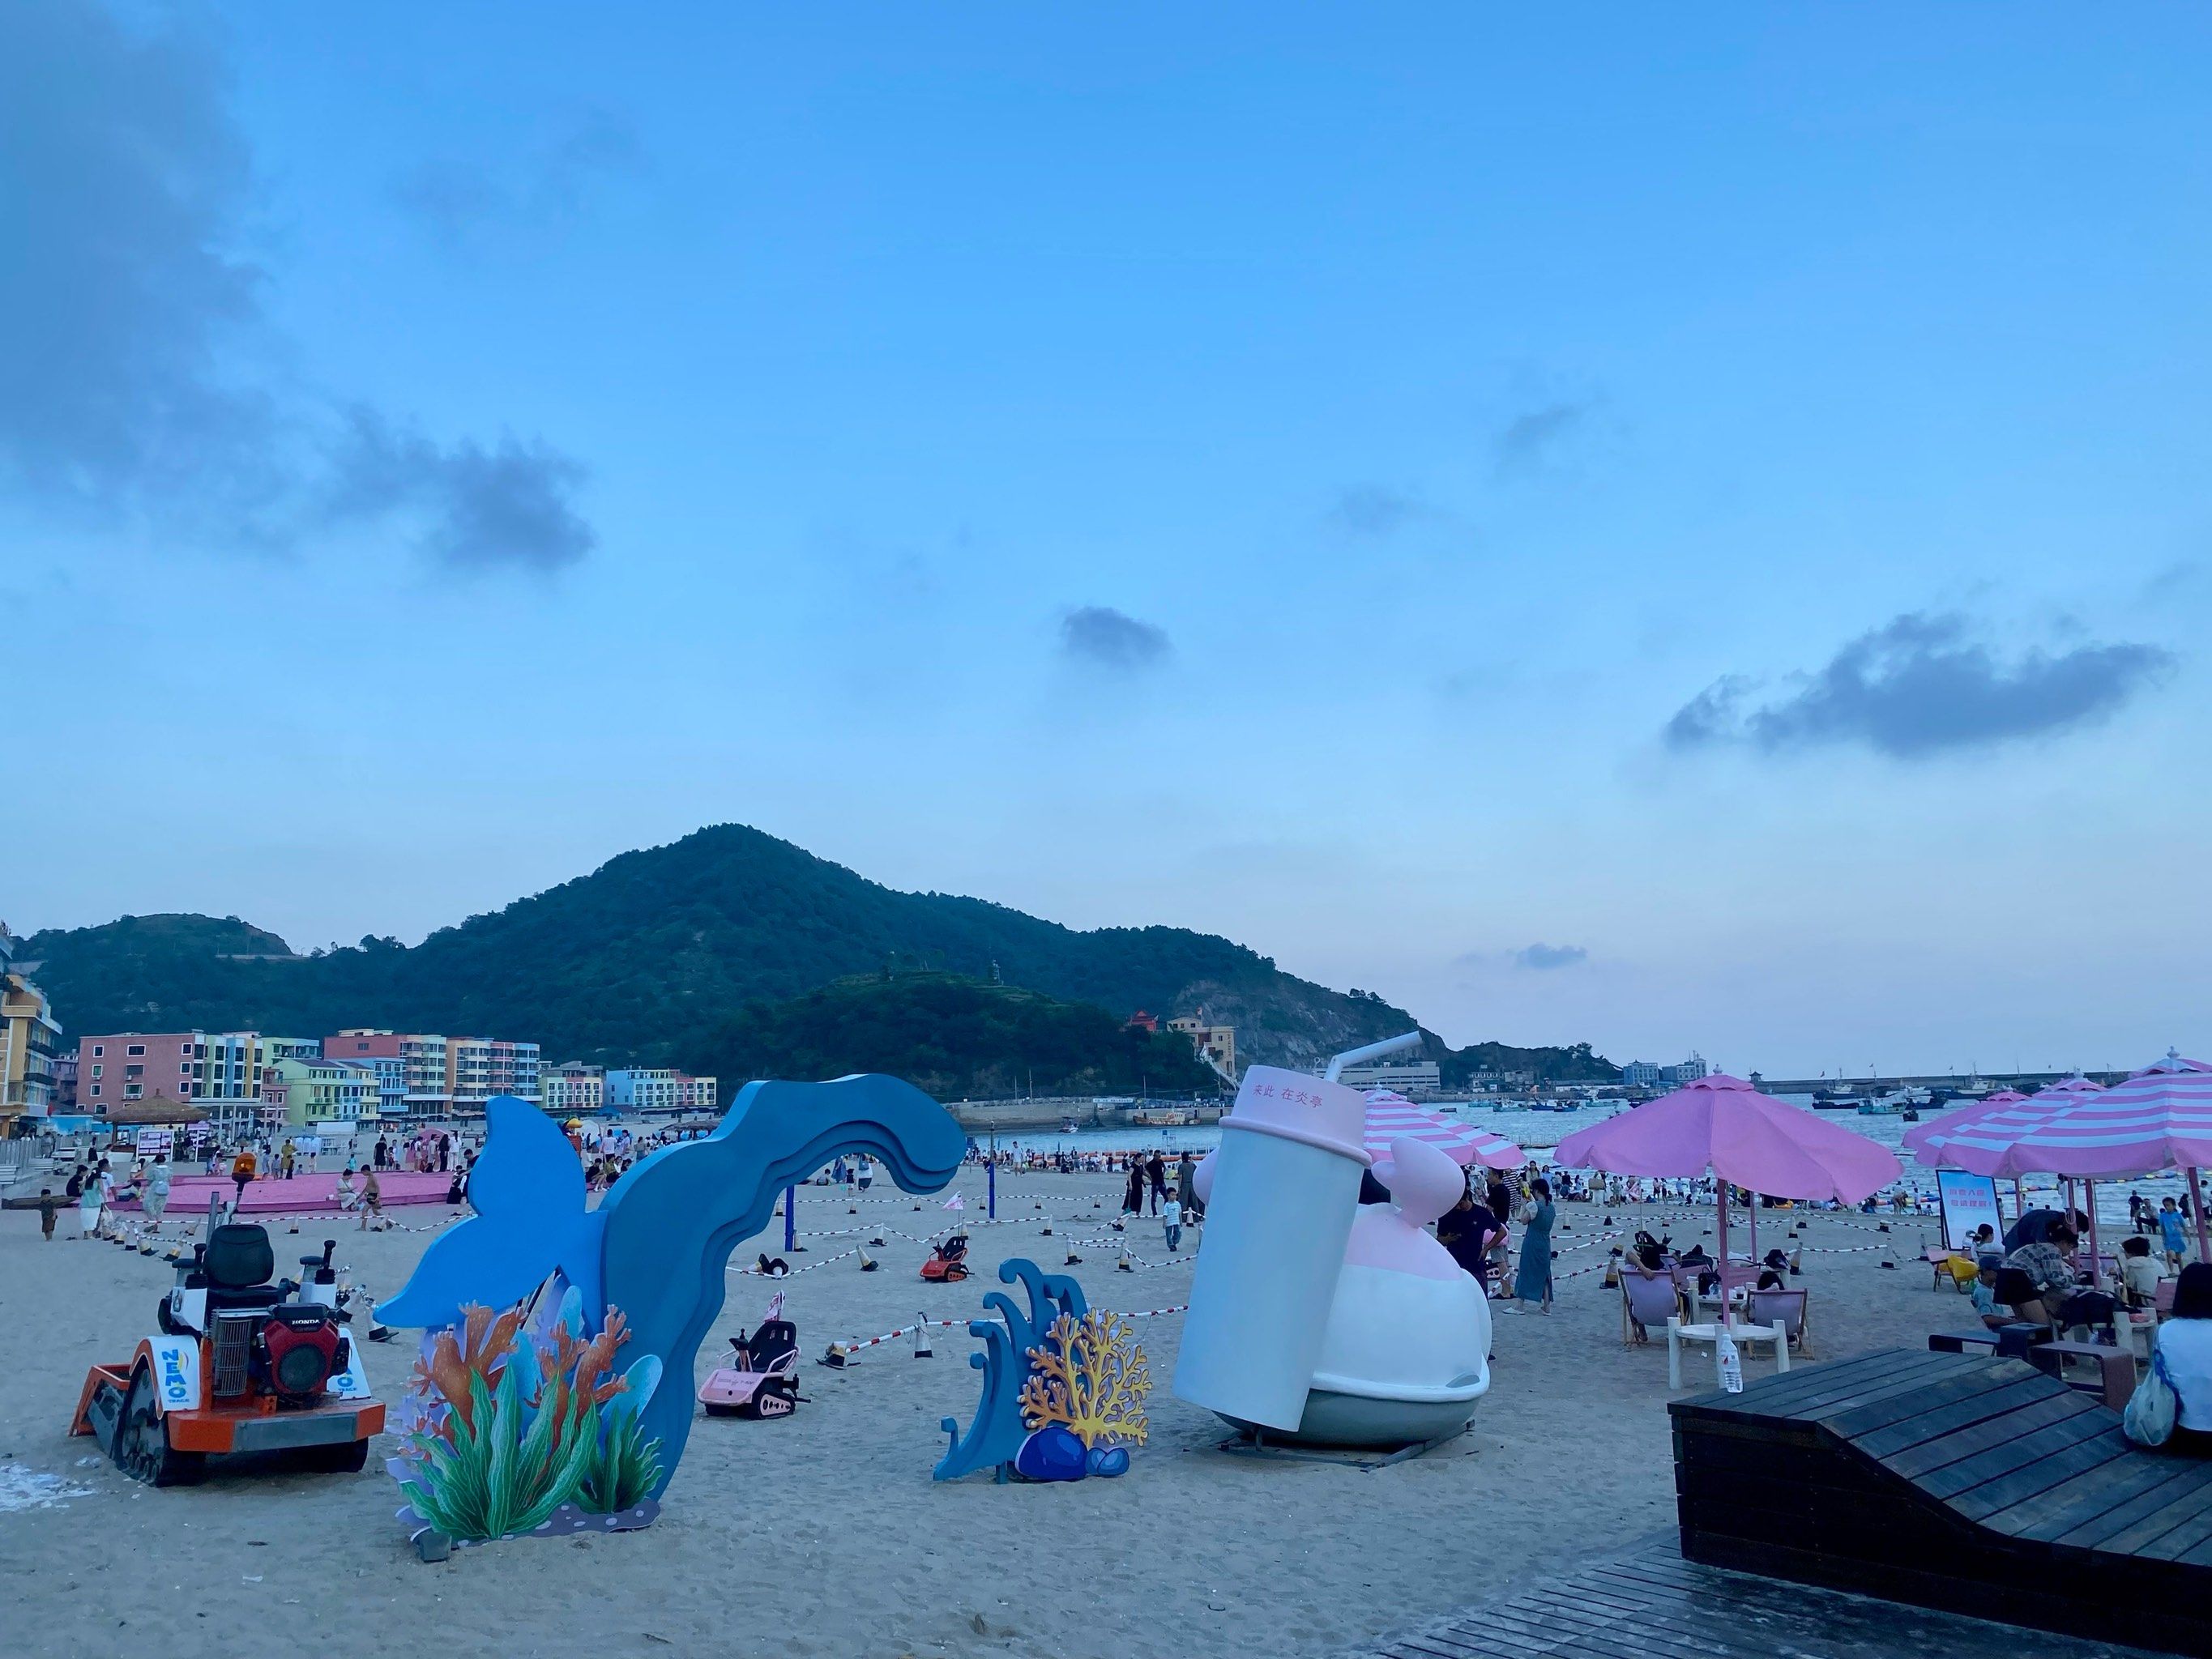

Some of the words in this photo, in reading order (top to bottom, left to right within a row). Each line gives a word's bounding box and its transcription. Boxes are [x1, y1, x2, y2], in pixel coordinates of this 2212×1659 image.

[1253, 1085, 1275, 1098] 来此
[1281, 1088, 1323, 1107] 在炎亭
[161, 1349, 186, 1398] NEMO
